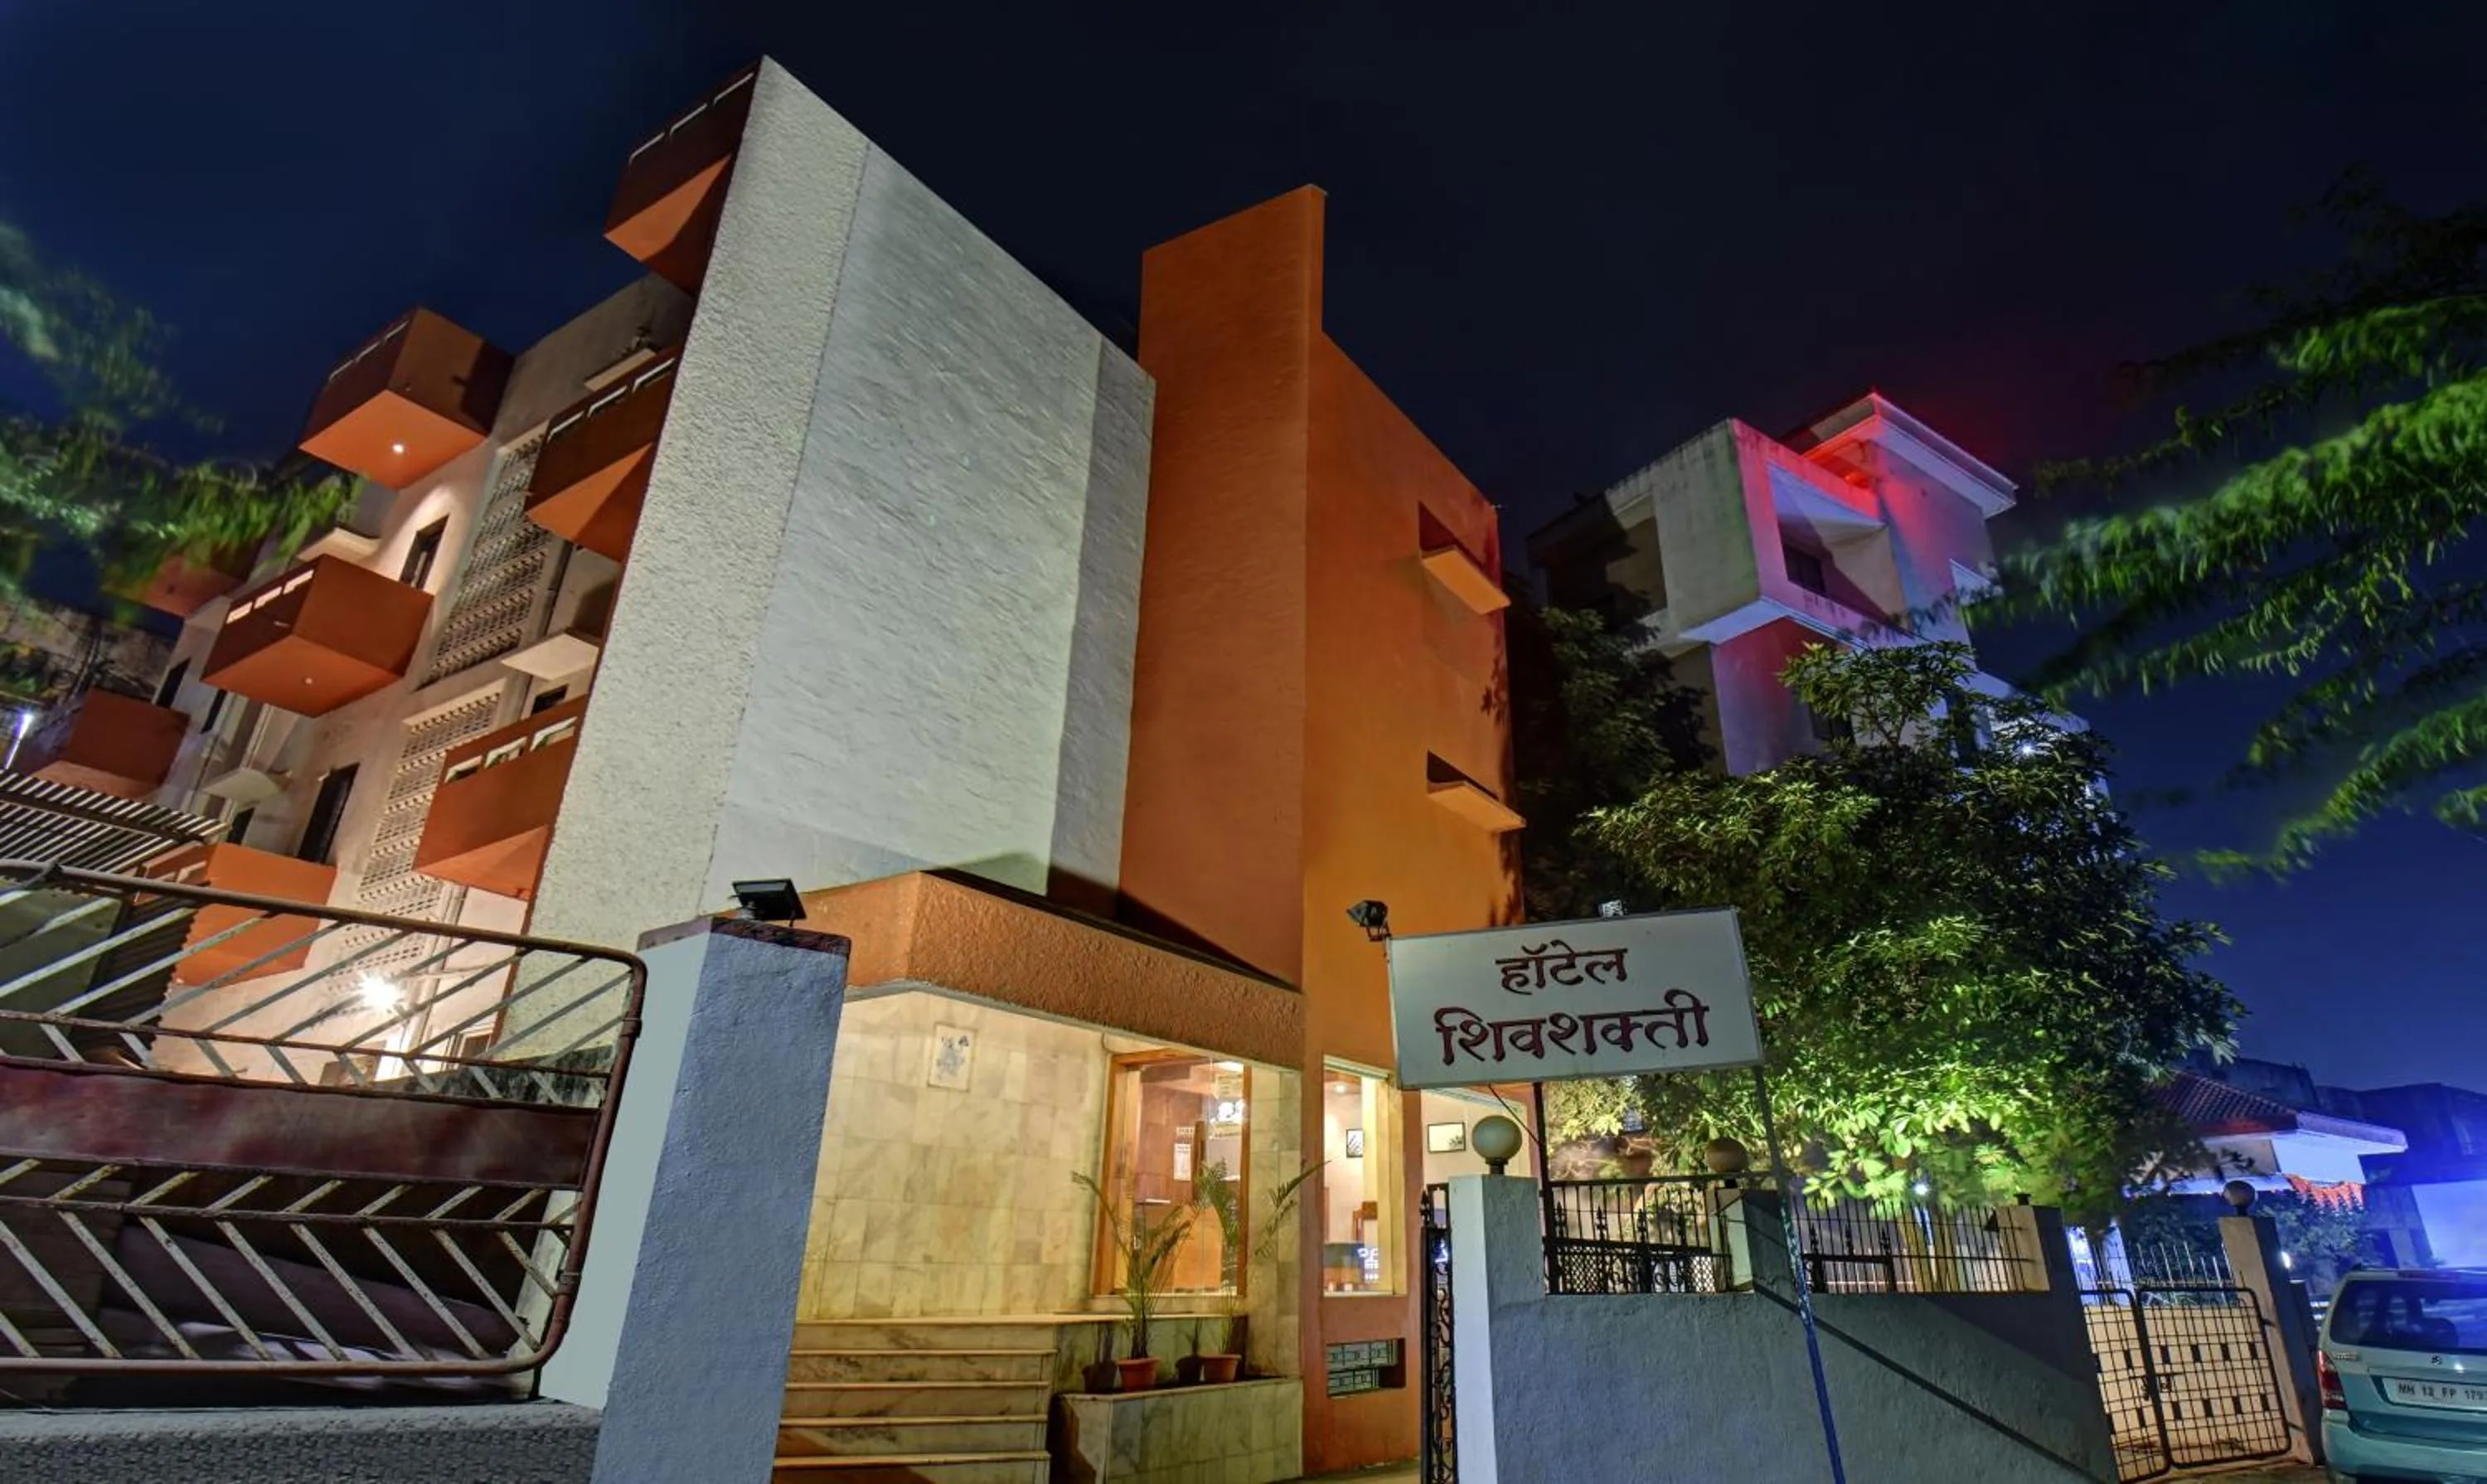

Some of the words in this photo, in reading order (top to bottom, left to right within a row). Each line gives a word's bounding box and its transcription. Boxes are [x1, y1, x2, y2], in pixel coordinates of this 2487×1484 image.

[1495, 938, 1629, 996] हॉटेल
[1433, 988, 1711, 1066] शिवशक्ती
[2398, 1383, 2416, 1395] MH
